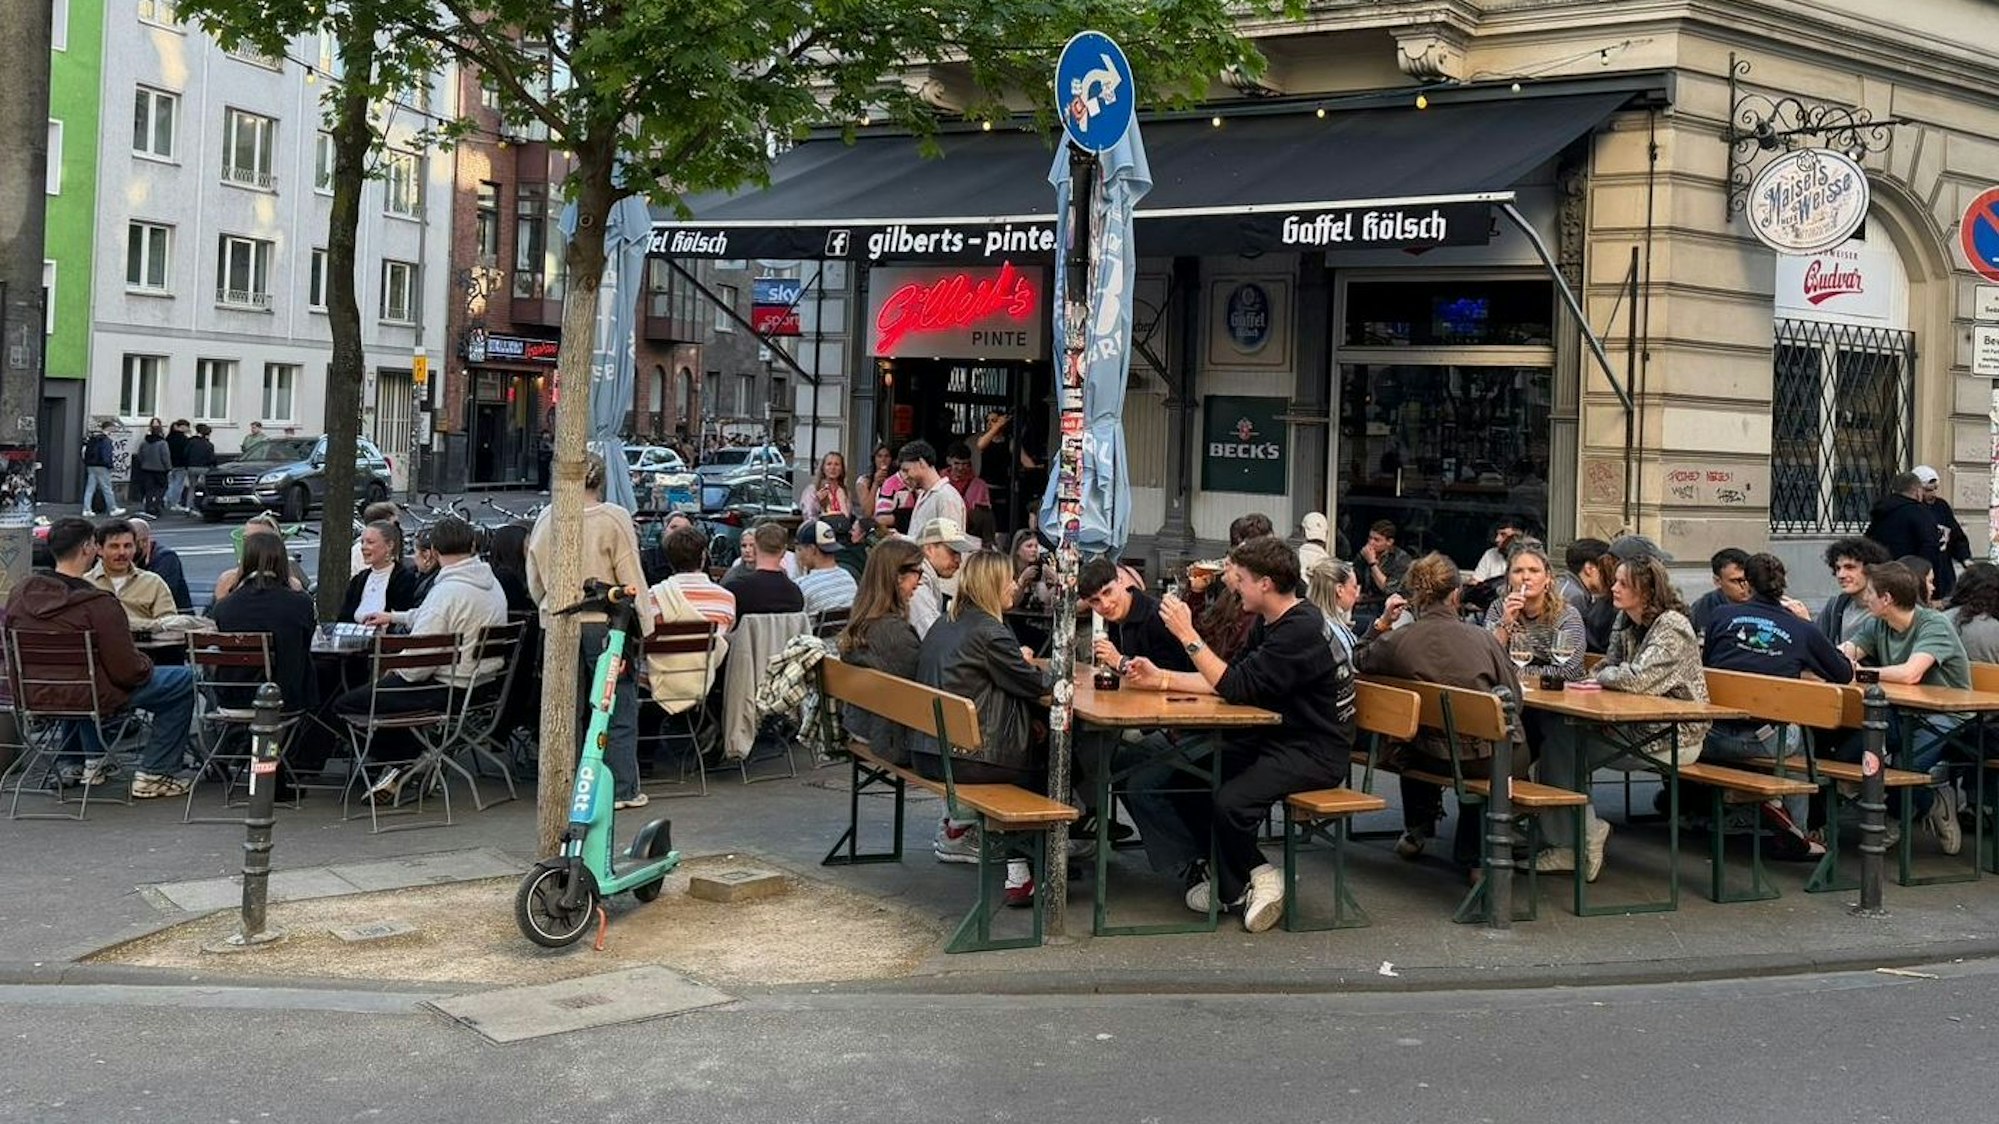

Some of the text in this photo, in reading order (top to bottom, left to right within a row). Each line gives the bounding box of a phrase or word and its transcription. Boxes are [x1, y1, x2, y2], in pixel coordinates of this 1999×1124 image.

[1795, 173, 1852, 225] Weisse
[1282, 209, 1447, 245] Gaffel Kölsch
[645, 230, 728, 255] fel Kölsch
[768, 284, 800, 305] sky
[1230, 312, 1266, 329] Gaffel
[972, 332, 1027, 346] PINTE
[1209, 442, 1280, 459] BECK'S
[574, 766, 595, 811] dott
